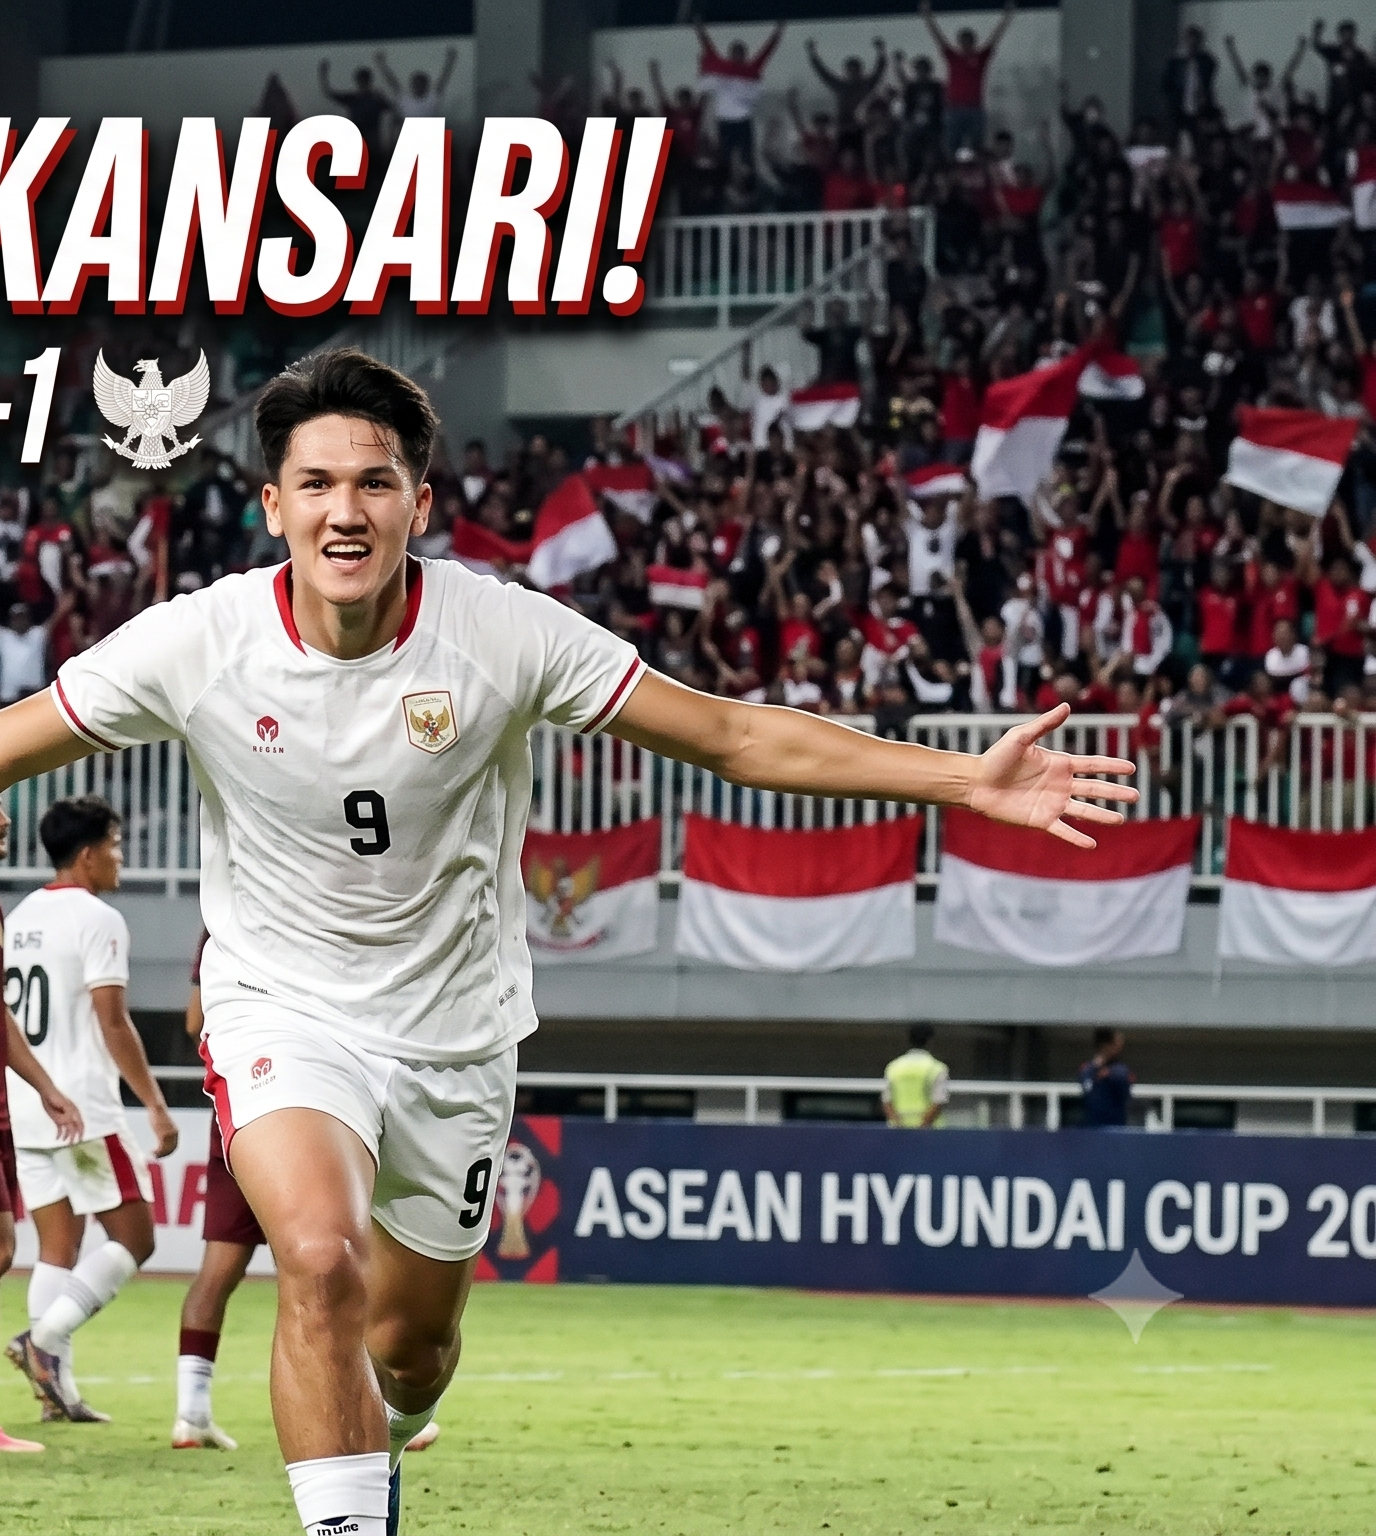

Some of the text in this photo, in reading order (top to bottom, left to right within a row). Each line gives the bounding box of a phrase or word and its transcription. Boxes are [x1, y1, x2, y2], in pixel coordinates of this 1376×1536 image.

[343, 789, 391, 856] 9
[458, 1156, 493, 1230] 9
[575, 1166, 1376, 1260] ASEAN HYUNDAI CUP 20
